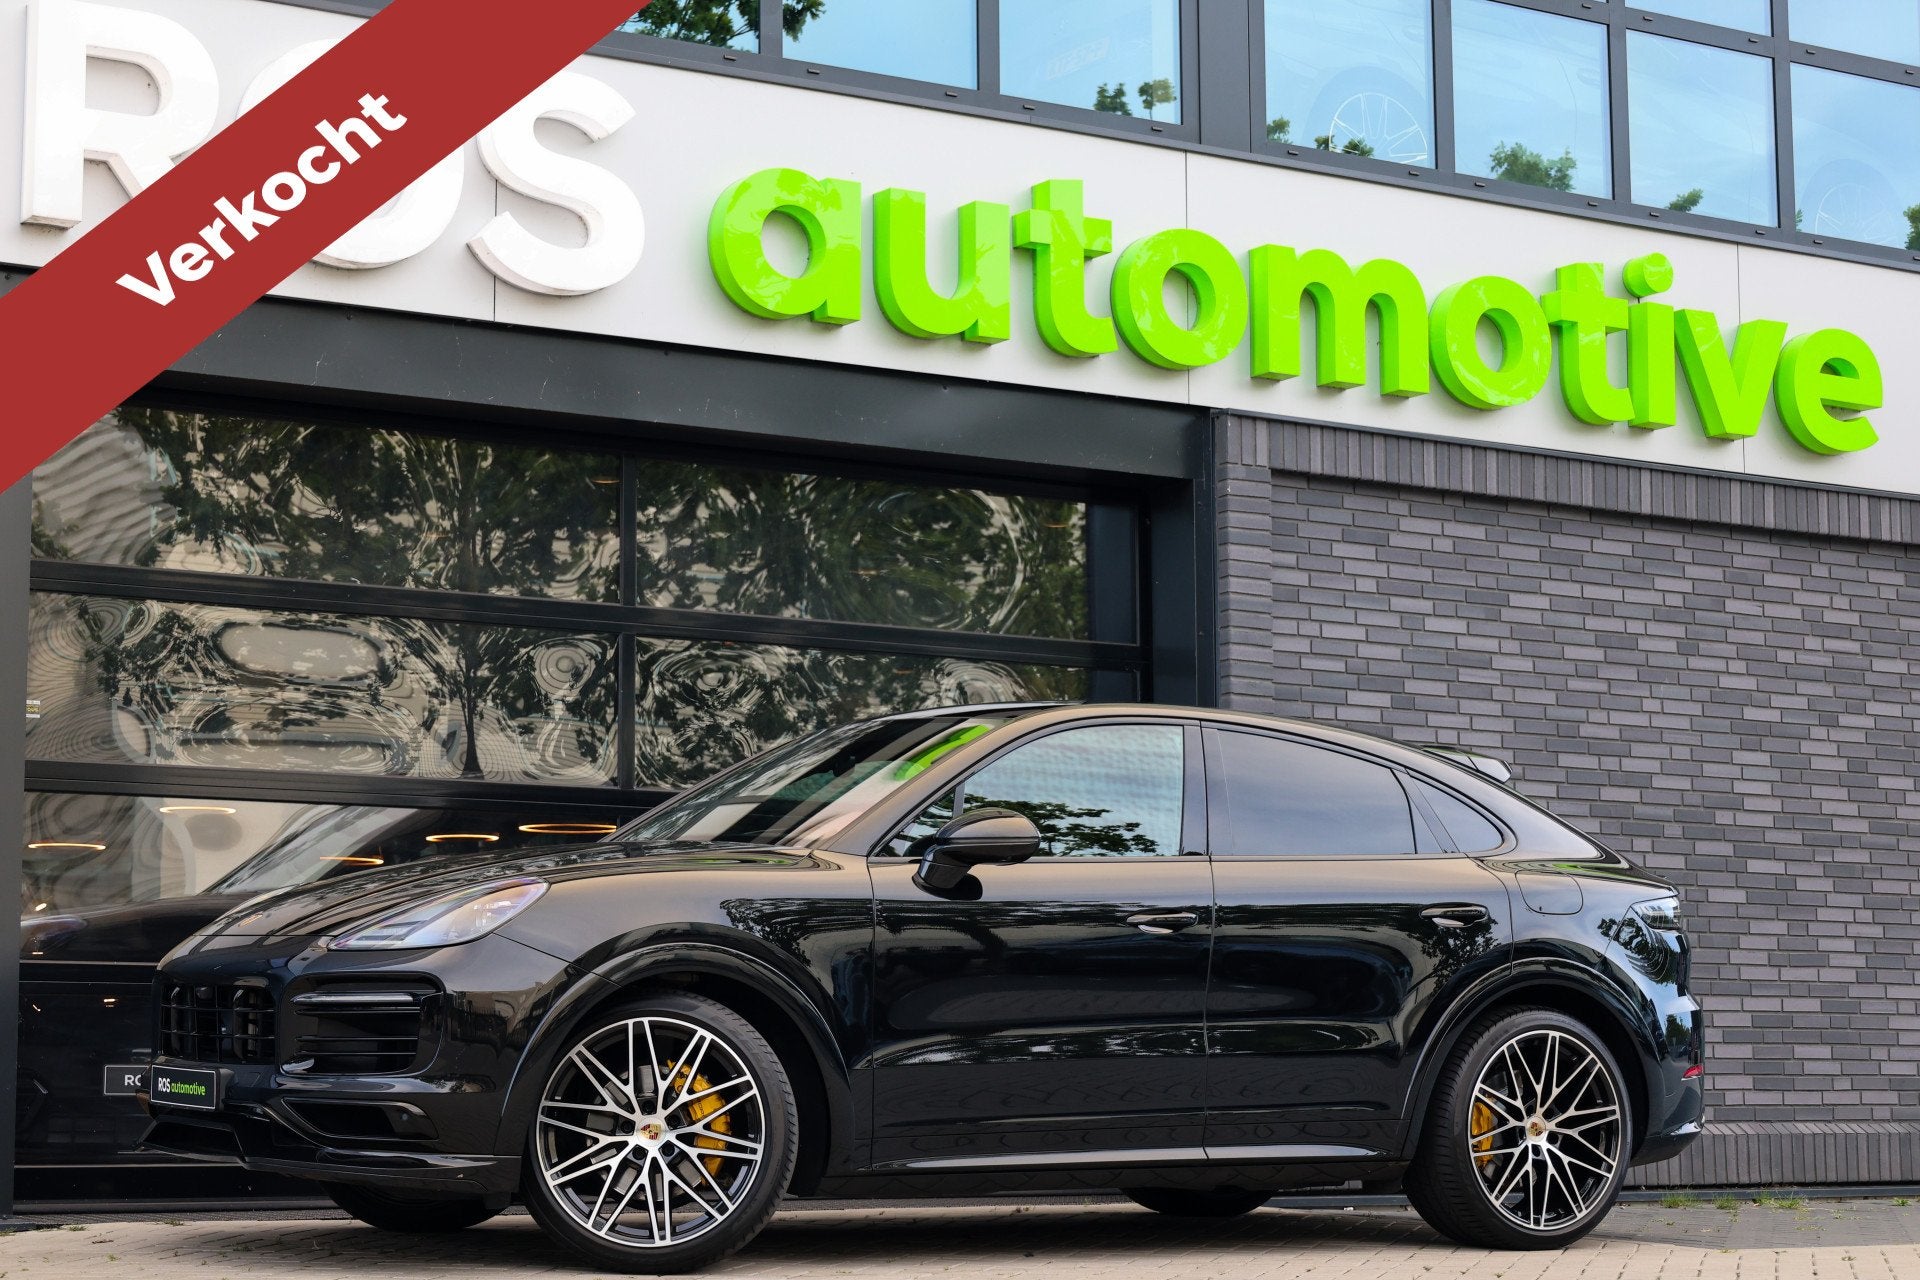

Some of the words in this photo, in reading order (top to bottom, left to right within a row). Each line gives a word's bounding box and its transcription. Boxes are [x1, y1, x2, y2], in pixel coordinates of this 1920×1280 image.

[709, 169, 1882, 456] automotive
[158, 1077, 171, 1093] ROS
[171, 1082, 206, 1096] automotive
